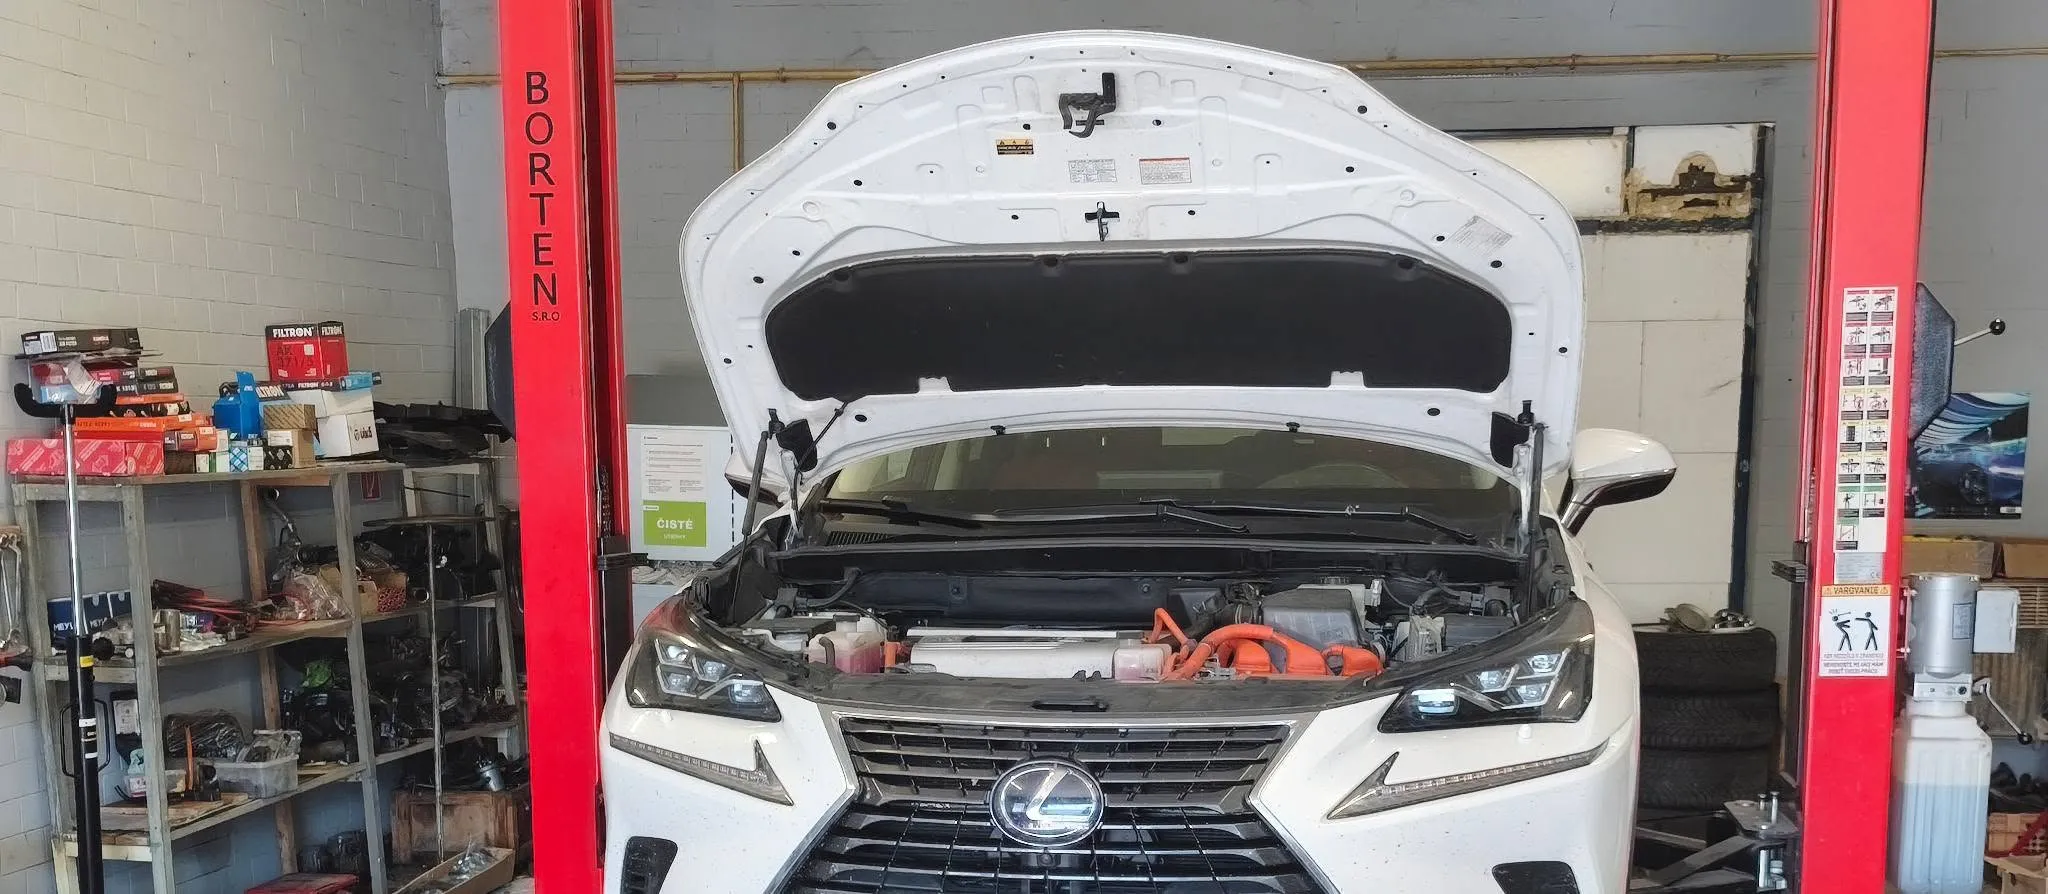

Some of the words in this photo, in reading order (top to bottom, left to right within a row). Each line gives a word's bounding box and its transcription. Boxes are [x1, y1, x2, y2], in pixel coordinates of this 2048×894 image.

[525, 71, 558, 306] BORTEN
[272, 327, 313, 338] FILTRON
[321, 325, 342, 336] FILTRON
[255, 384, 285, 399] ILTRON
[656, 517, 694, 530] ČISTÉ
[53, 621, 74, 631] MEYL
